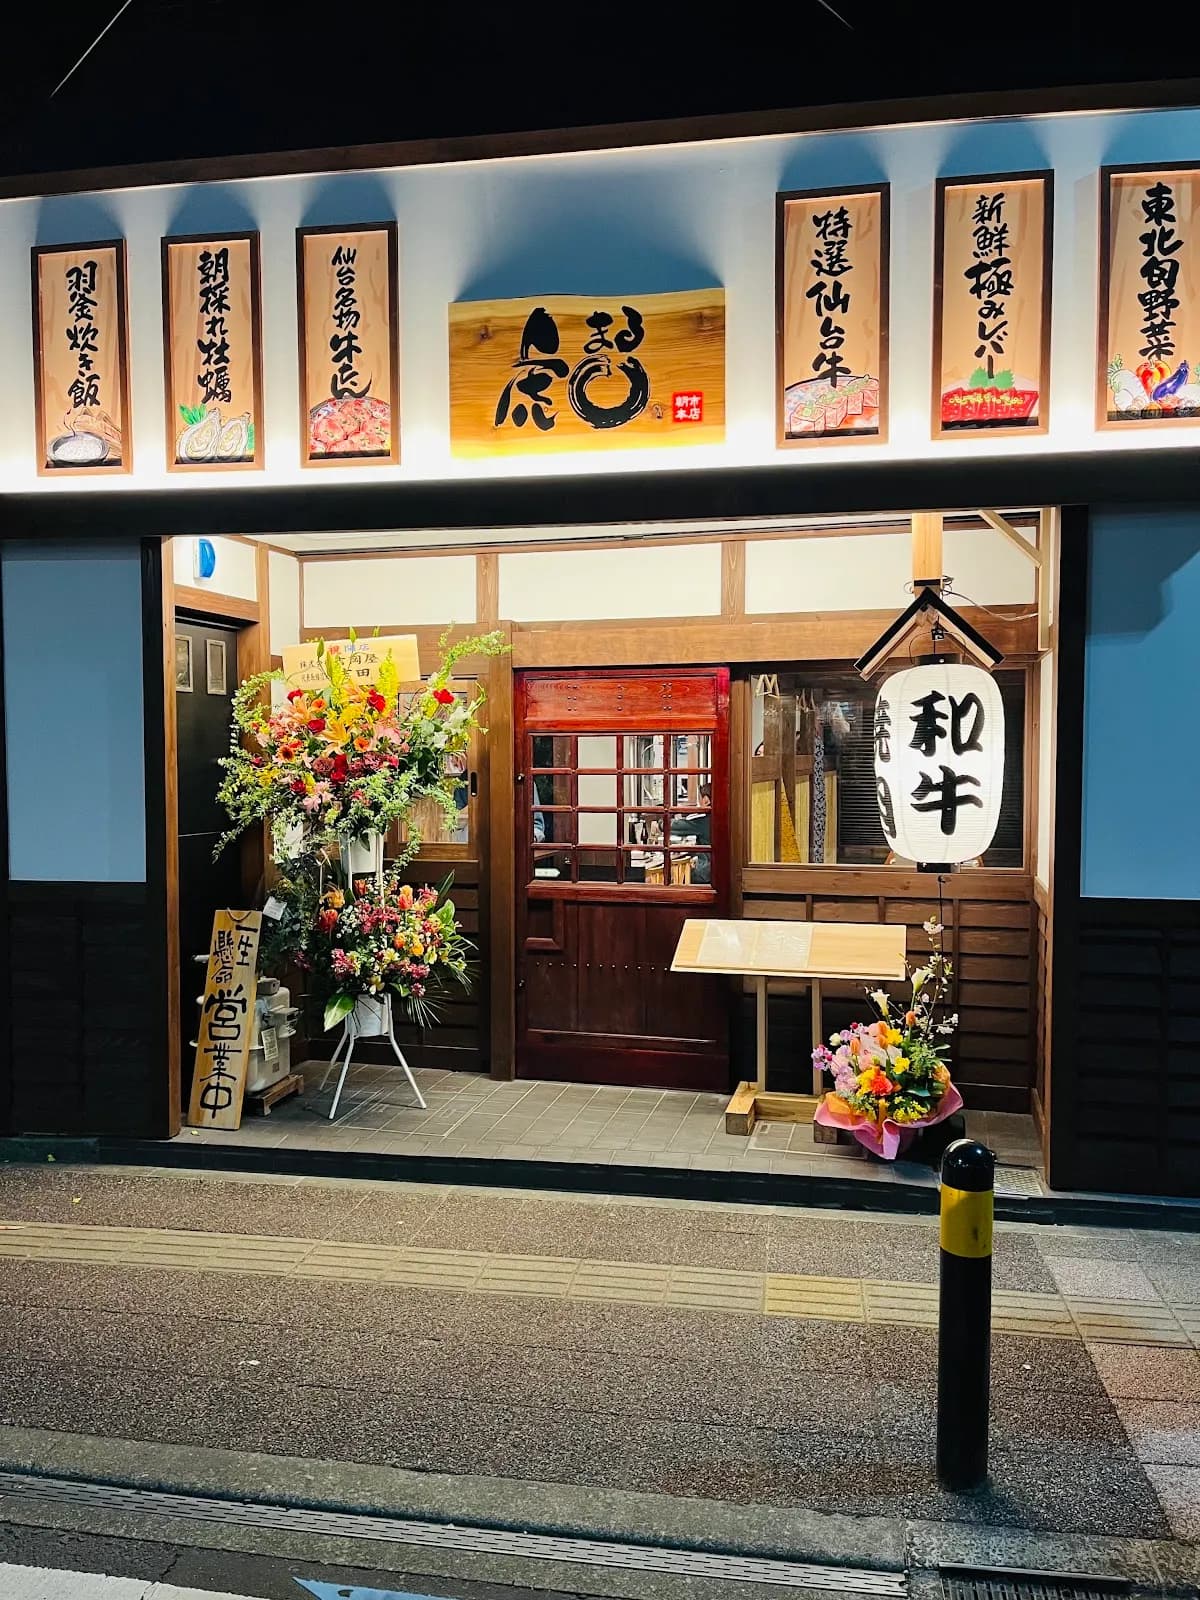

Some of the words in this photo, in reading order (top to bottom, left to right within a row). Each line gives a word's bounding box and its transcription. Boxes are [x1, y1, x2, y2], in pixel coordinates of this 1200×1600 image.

[65, 260, 101, 408] 羽釜炊き飯
[197, 247, 232, 404] 朝採れ牡蠣
[329, 245, 372, 400] 仙台名物牛たん
[805, 205, 854, 389] 特選仙台牛
[964, 192, 1015, 379] 新鮮極みレバー
[1138, 181, 1185, 361] 東北旬野菜
[908, 690, 985, 836] 和牛
[199, 984, 247, 1119] 営業中
